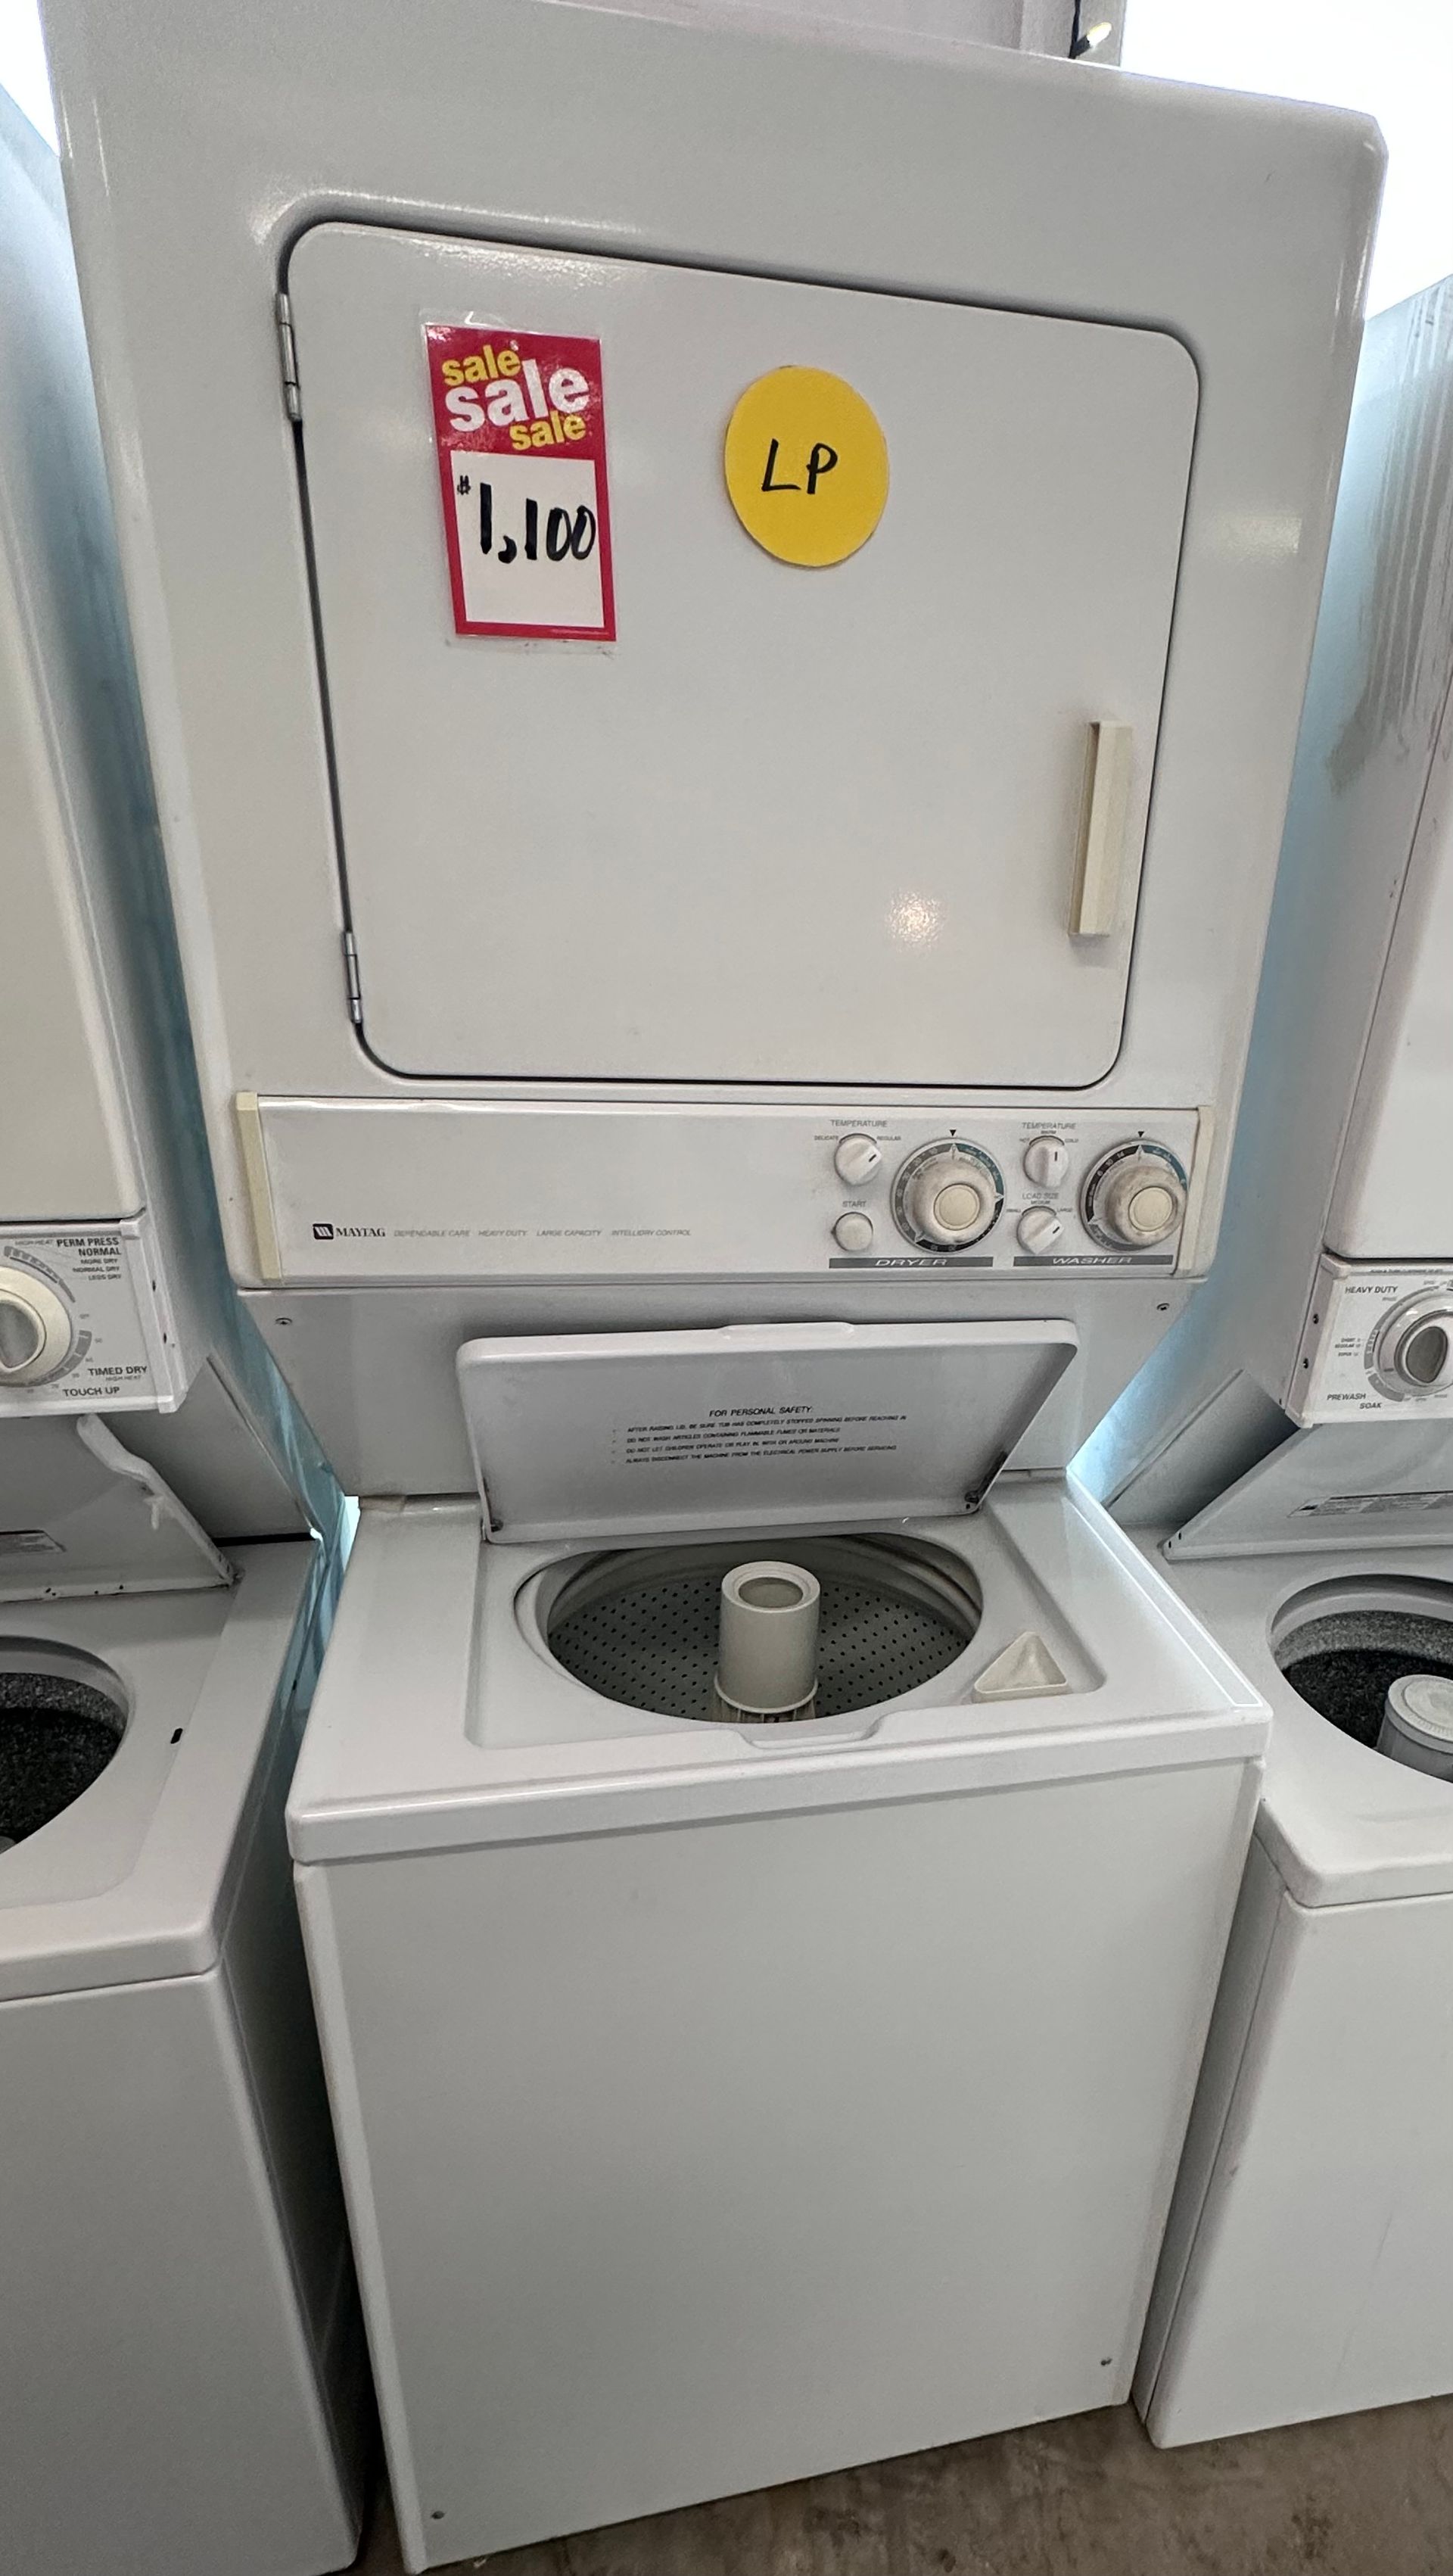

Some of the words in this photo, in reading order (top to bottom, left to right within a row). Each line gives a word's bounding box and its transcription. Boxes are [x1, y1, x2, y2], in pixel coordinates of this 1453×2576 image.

[442, 344, 521, 386] sale
[446, 359, 590, 432] sale
[509, 410, 586, 450] sale
[761, 438, 839, 495] LP
[335, 1227, 385, 1238] MAYTAG
[56, 1238, 85, 1248] PERM
[87, 1238, 120, 1246] PRESS
[78, 1248, 122, 1257] NORMAL
[88, 1367, 123, 1376] TIMED
[126, 1366, 148, 1375] DRY
[63, 1388, 102, 1397] TOUCH
[105, 1386, 120, 1394] UP
[730, 1408, 775, 1416] PERSONAL
